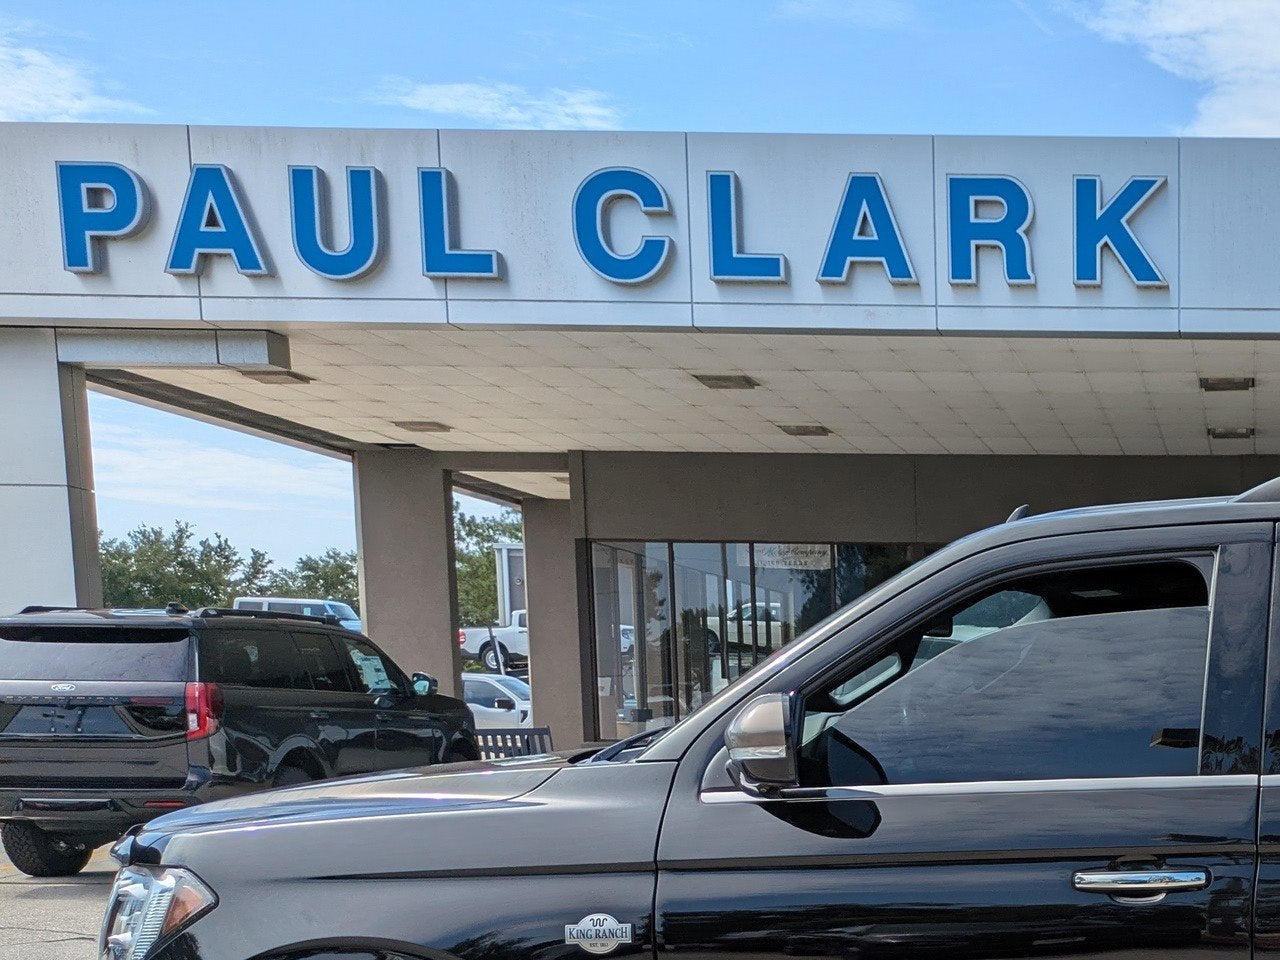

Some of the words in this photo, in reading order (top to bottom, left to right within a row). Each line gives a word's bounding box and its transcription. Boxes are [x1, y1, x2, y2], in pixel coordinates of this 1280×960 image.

[54, 161, 504, 282] PAUL
[571, 165, 1169, 289] CLARK
[568, 927, 593, 940] KING
[594, 926, 629, 939] RANCH
